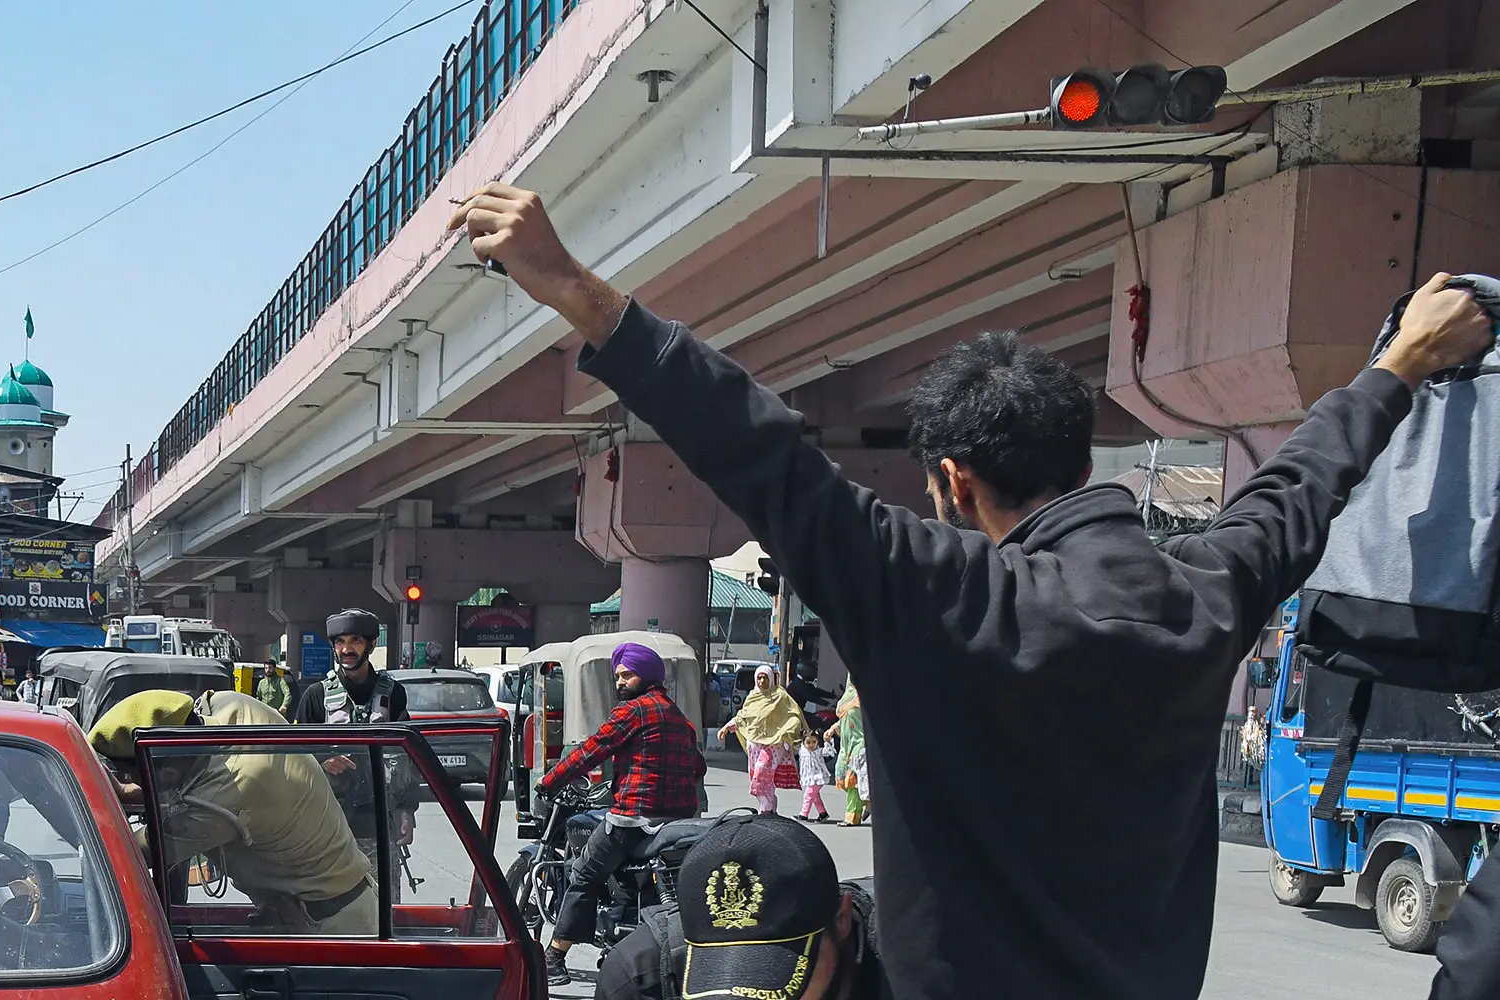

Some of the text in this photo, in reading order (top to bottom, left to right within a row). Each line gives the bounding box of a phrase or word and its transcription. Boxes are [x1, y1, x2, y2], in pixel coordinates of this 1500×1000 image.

[33, 540, 68, 549] CORNER
[0, 594, 86, 609] OOD CORNER
[784, 954, 809, 997] FORCES
